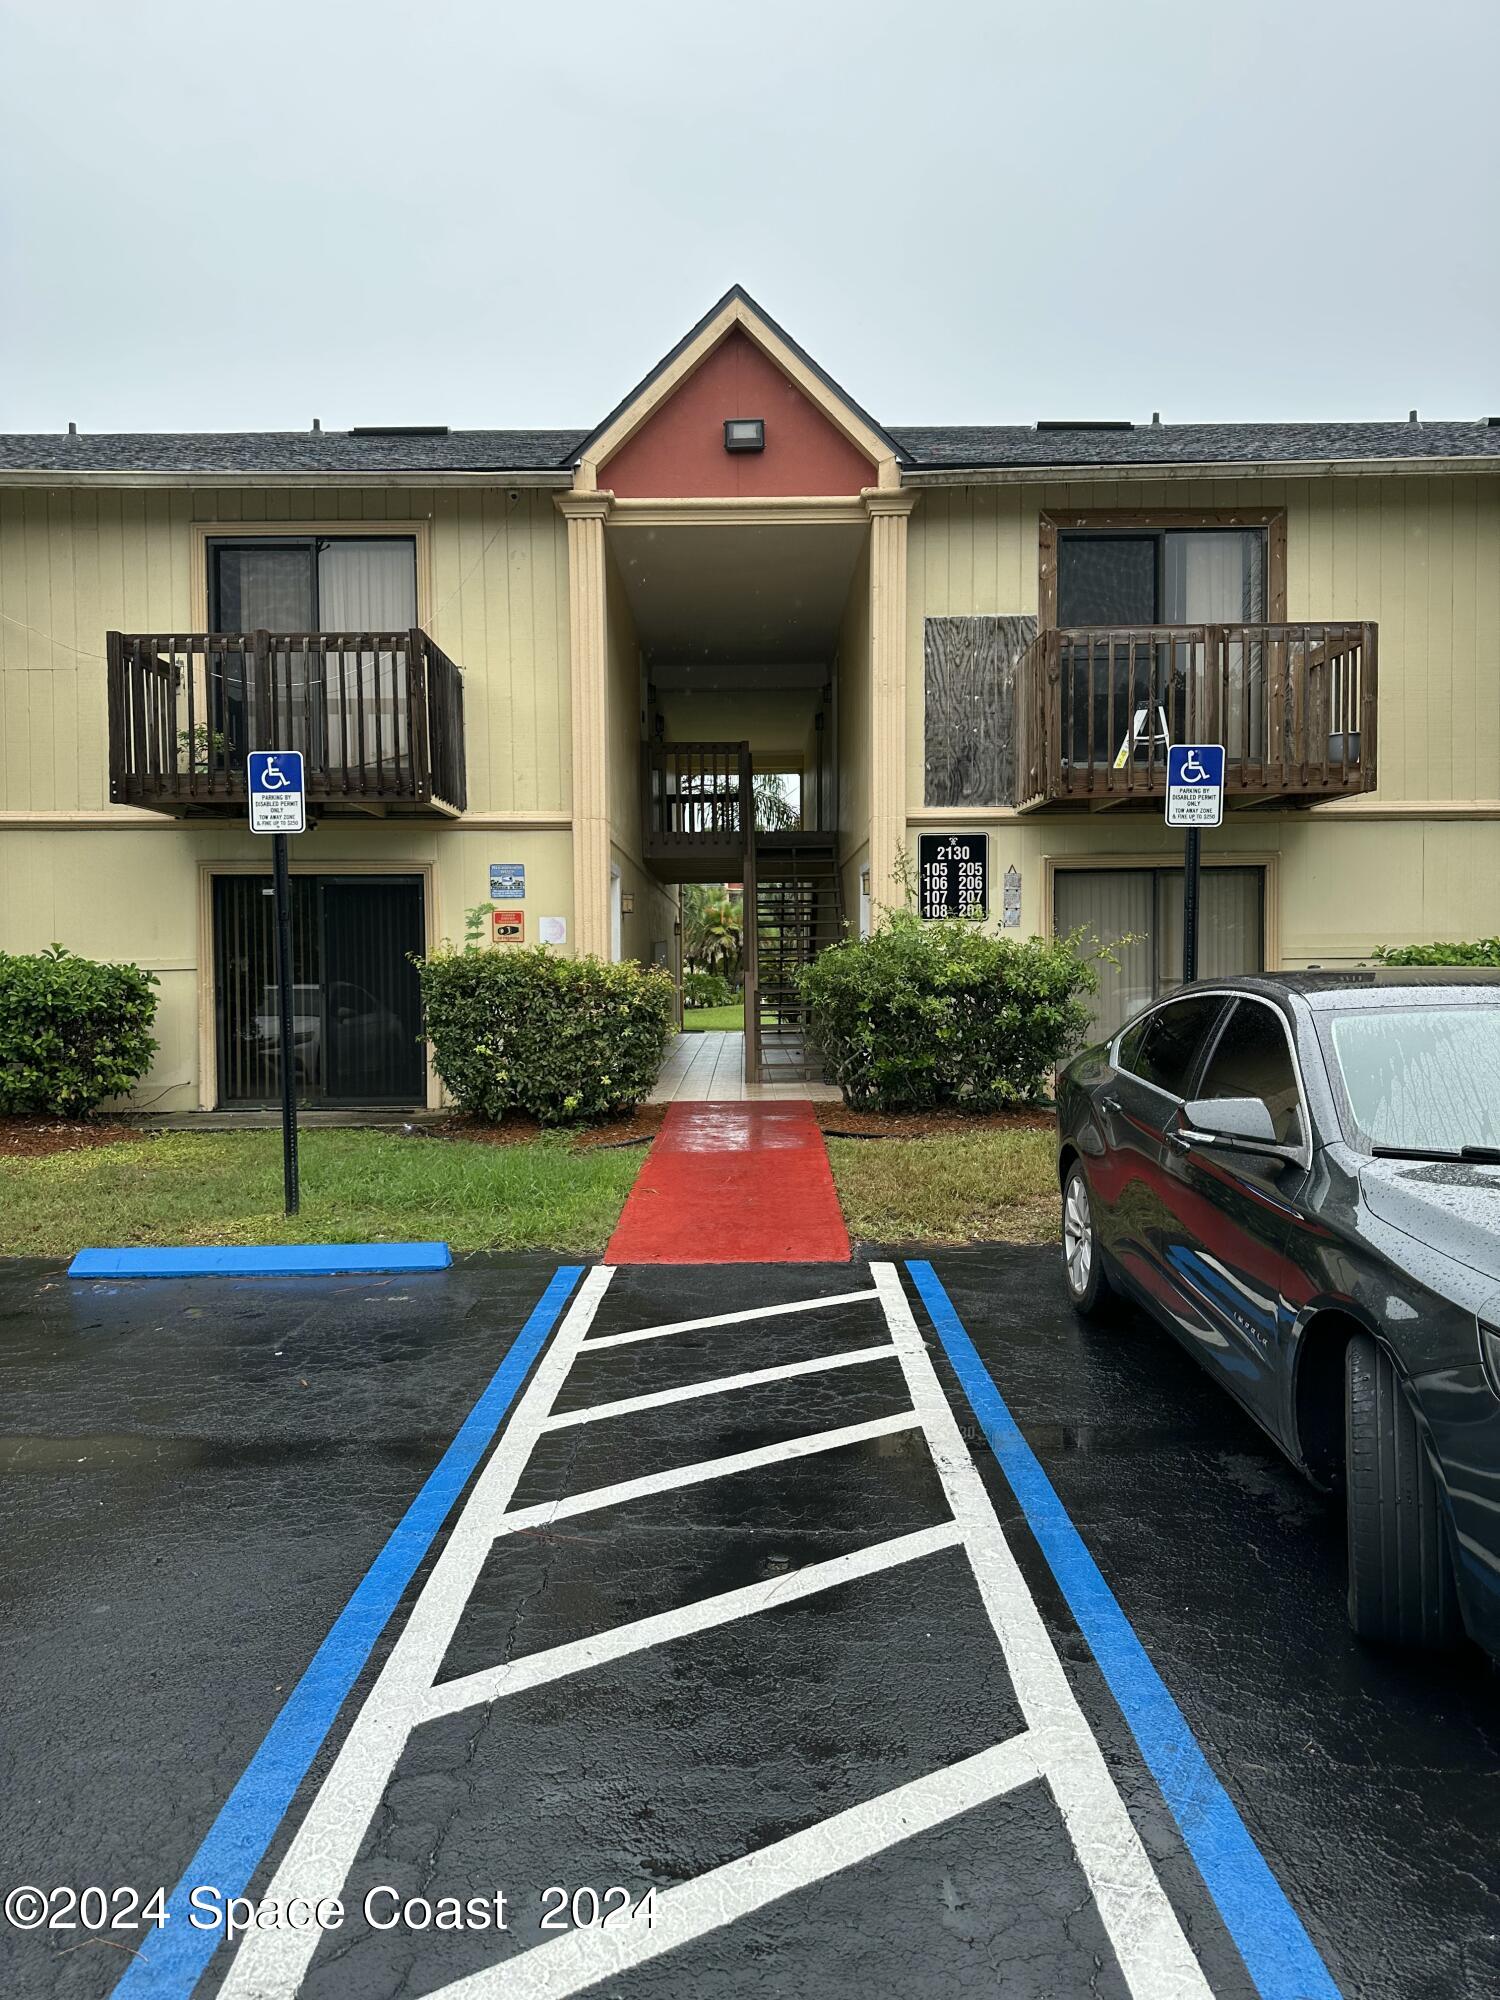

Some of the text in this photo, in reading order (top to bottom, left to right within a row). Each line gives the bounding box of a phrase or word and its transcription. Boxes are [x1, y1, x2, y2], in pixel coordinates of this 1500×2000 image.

[937, 846, 970, 860] 2130
[924, 863, 983, 876] 105 205
[924, 876, 983, 890] 106 206
[924, 890, 983, 904] 107 207
[924, 904, 948, 918] 108
